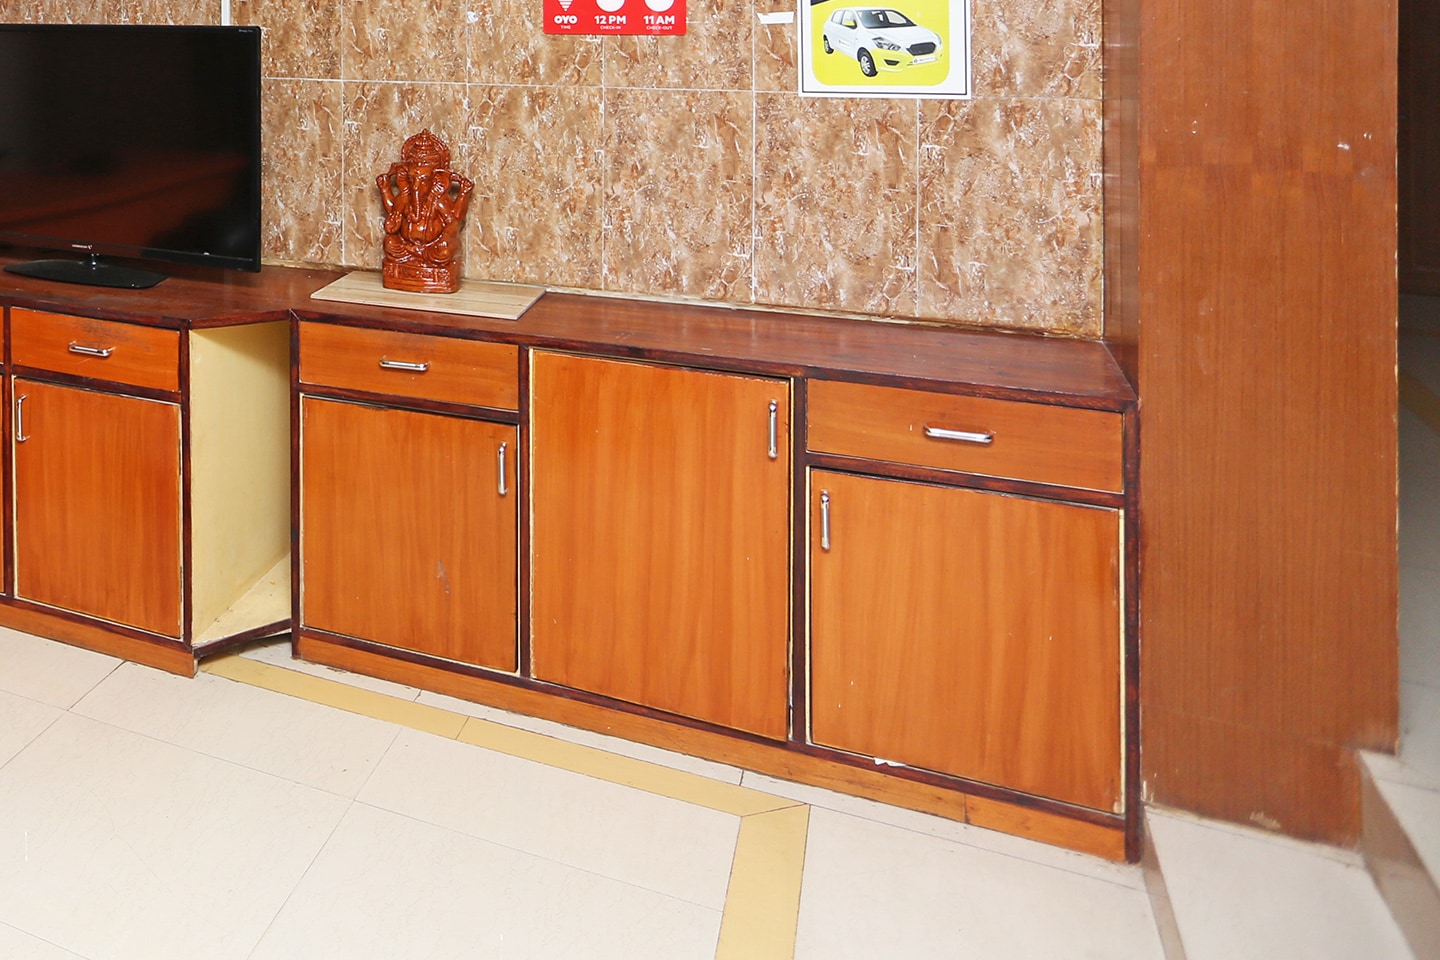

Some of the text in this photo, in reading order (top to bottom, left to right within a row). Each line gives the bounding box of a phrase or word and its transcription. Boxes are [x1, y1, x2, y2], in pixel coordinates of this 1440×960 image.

[553, 15, 578, 25] OYO
[594, 15, 627, 25] 12 PM
[643, 15, 675, 25] 11 AM
